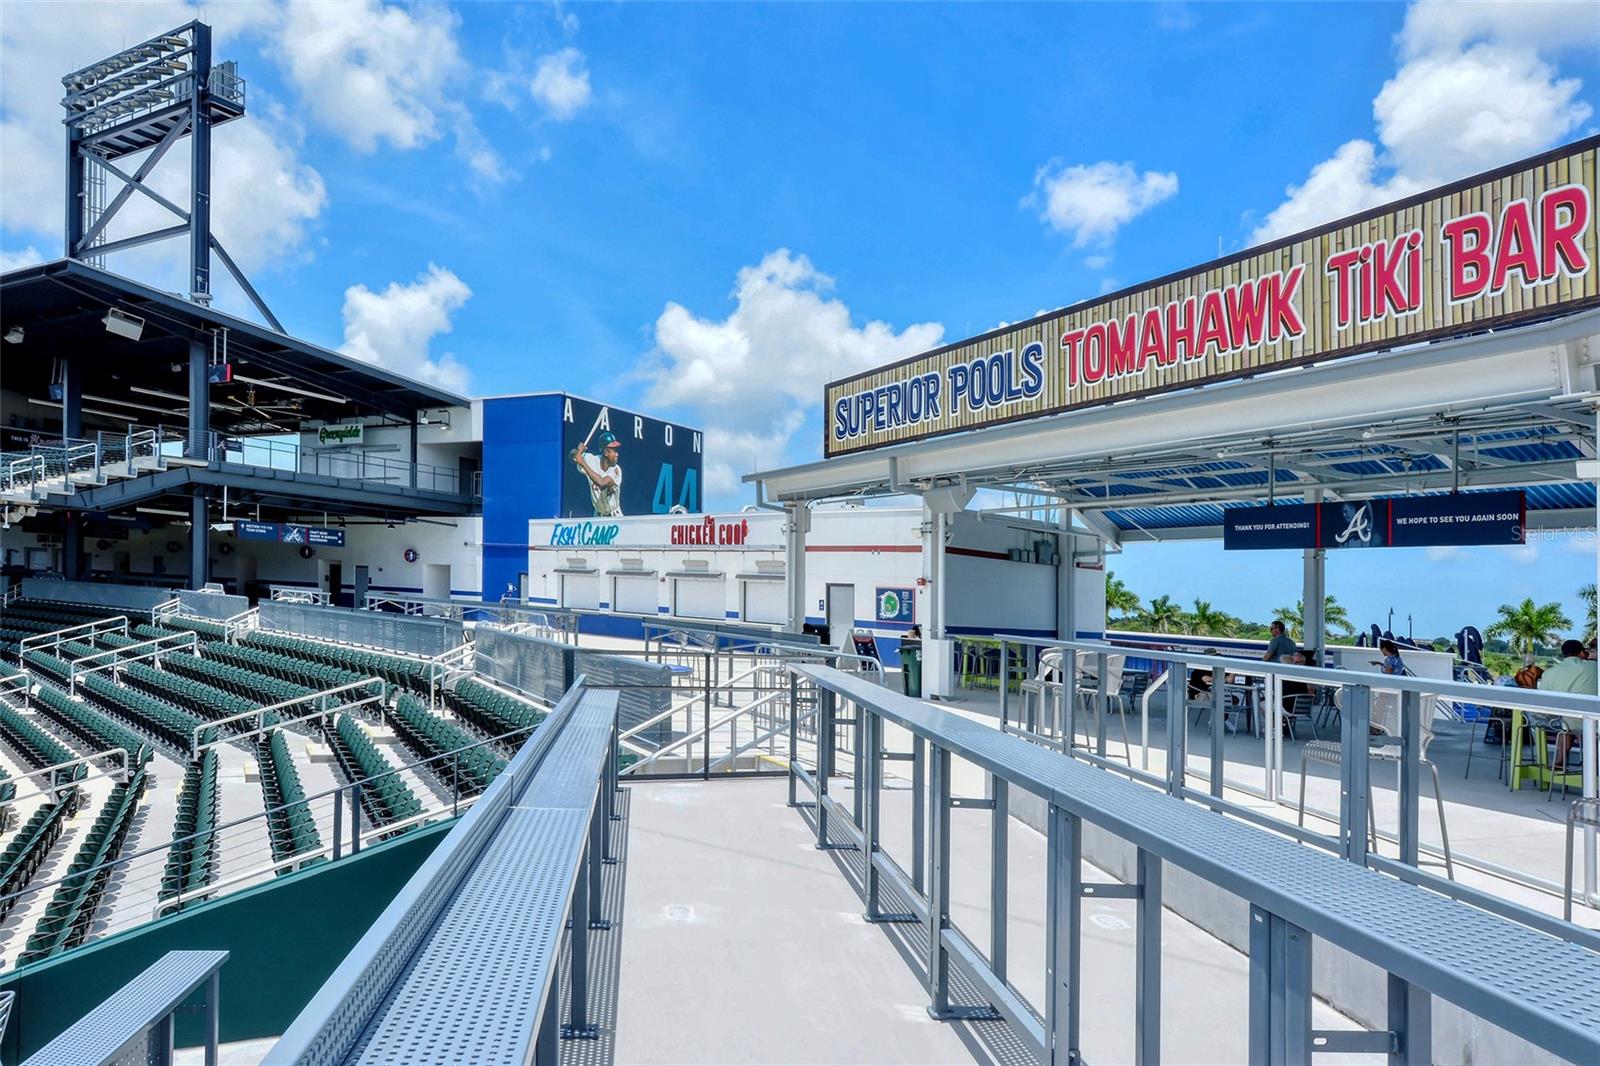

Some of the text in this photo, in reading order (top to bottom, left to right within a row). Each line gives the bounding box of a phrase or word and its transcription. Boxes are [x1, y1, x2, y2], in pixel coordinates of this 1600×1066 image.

[835, 371, 941, 441] SUPERIOR
[948, 341, 1045, 415] POOLS
[1060, 264, 1306, 390] TOMAHAWK
[1440, 183, 1591, 304] BAR
[563, 398, 702, 453] AARON
[652, 462, 698, 513] 44
[671, 518, 749, 545] CHICKEN COOP
[1275, 522, 1310, 530] ATTENDING!
[1396, 517, 1408, 525] WE
[1408, 516, 1428, 524] HOPE
[1439, 515, 1454, 523] SEE
[1471, 513, 1495, 522] AGAIN
[1496, 512, 1519, 521] SOON
[550, 520, 619, 545] FISH CAMP
